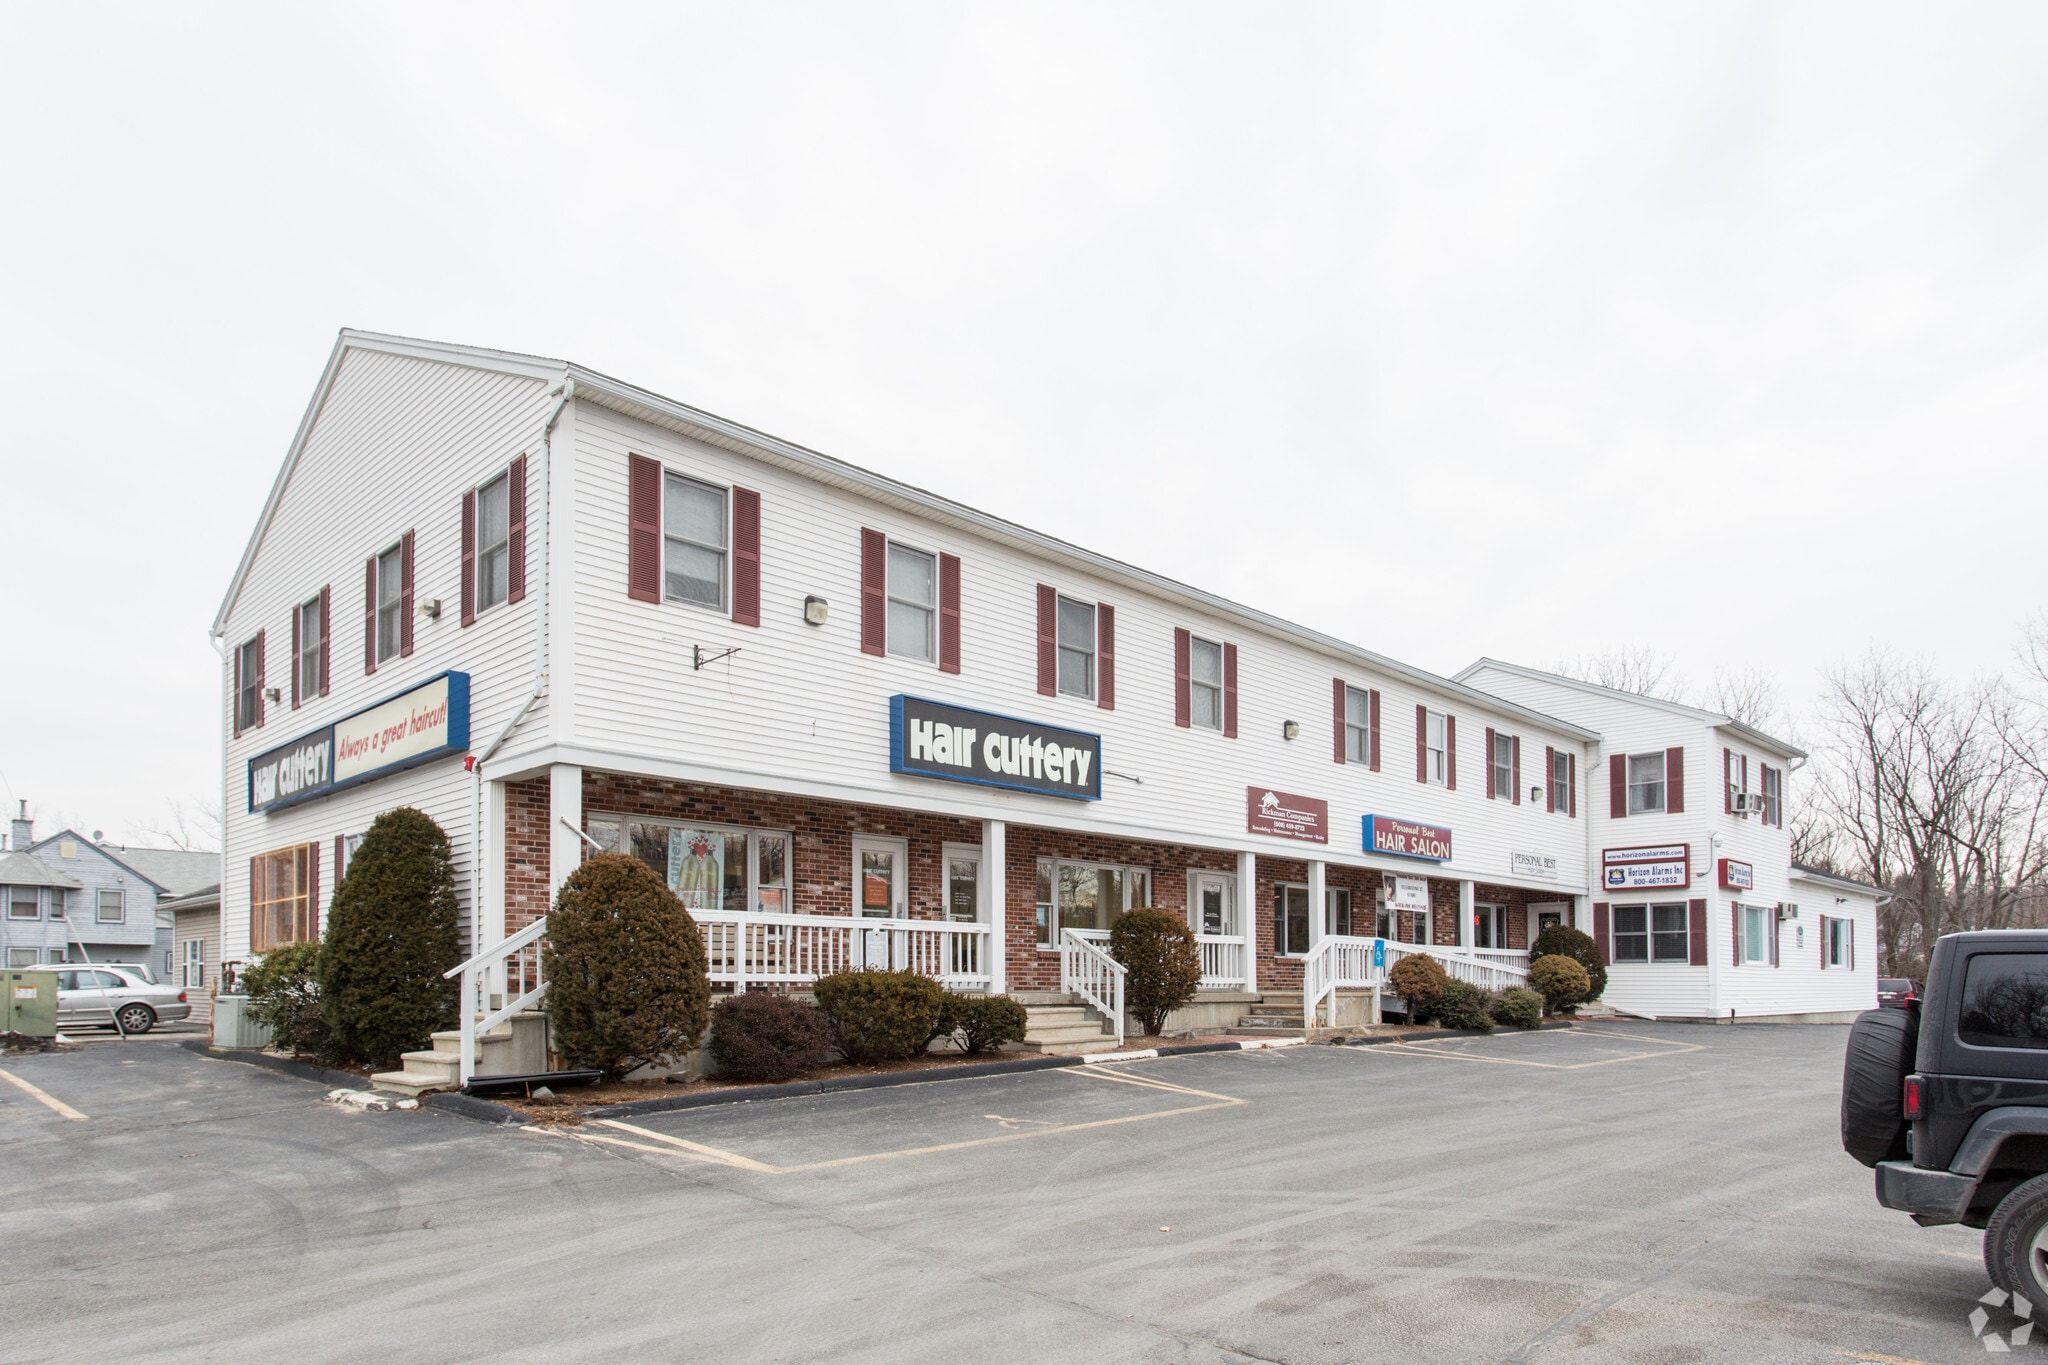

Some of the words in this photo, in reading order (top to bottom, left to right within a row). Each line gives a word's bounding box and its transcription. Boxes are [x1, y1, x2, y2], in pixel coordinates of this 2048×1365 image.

[338, 735, 369, 762] Always
[372, 732, 379, 749] a
[382, 718, 407, 753] great
[409, 696, 448, 736] haircut!
[910, 718, 976, 768] Hair
[254, 760, 278, 805] Hair
[1286, 811, 1315, 823] Companies
[1391, 821, 1419, 836] Personal
[1422, 827, 1435, 838] Best
[1376, 831, 1406, 852] HAIR
[1411, 837, 1450, 859] SALON
[1515, 853, 1542, 867] PERSONAL
[1544, 857, 1556, 869] BEST
[1607, 850, 1683, 860] www.horizonalarms.com
[1628, 867, 1650, 877] Horizon
[1652, 866, 1673, 875] Alarms
[1674, 865, 1683, 874] Inc
[1634, 877, 1678, 885] 800-467-1832
